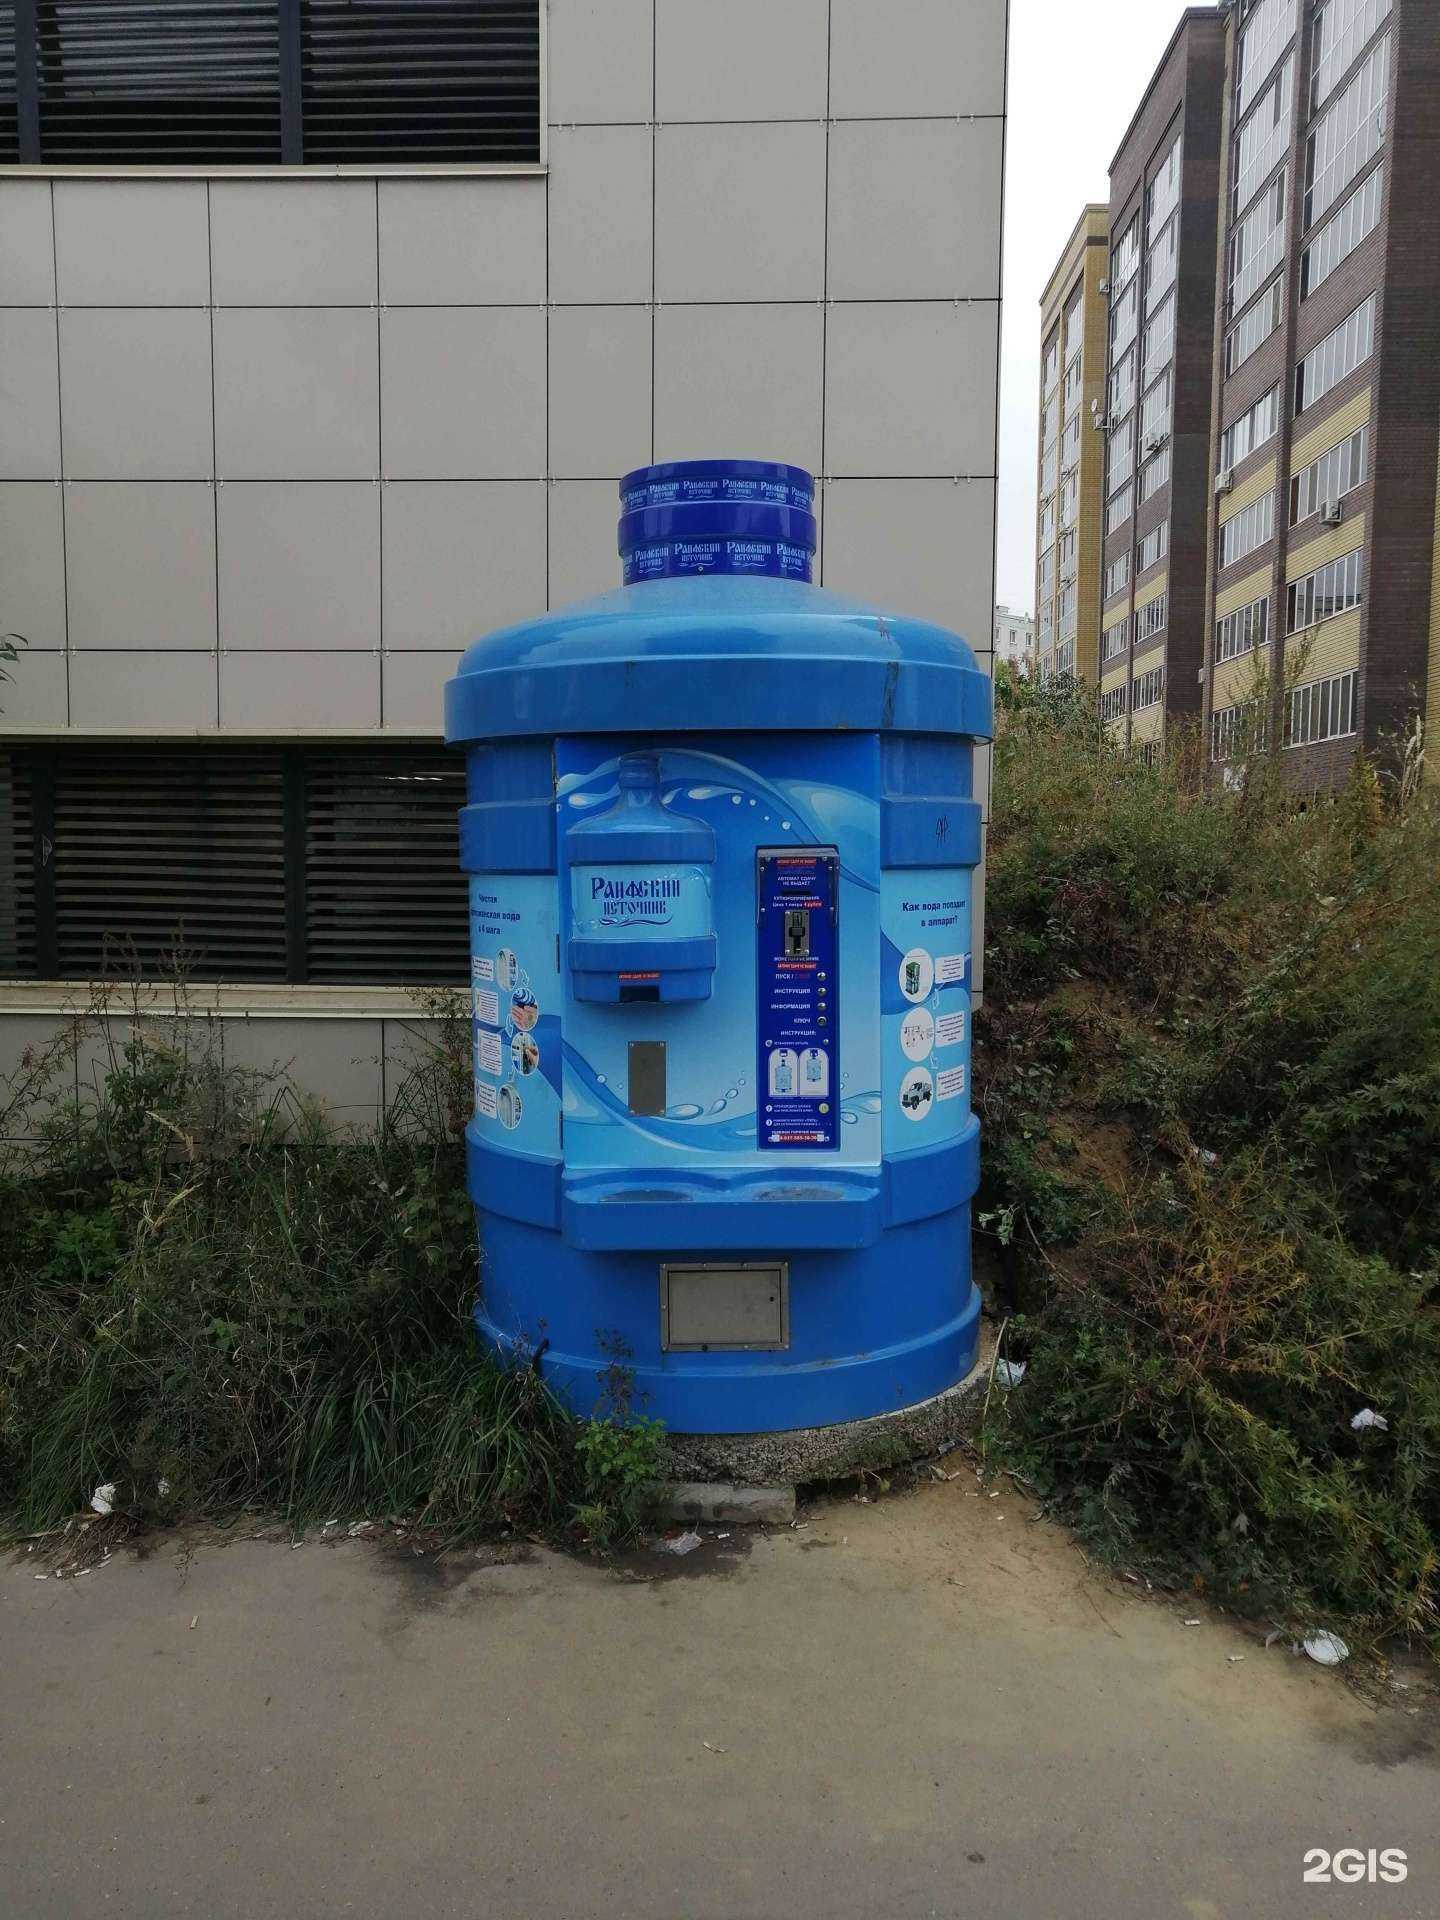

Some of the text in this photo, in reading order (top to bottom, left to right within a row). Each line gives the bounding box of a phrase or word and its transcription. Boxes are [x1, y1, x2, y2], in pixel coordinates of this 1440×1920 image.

[902, 902, 920, 912] Как
[922, 902, 941, 912] вода
[928, 915, 958, 928] аппарат?
